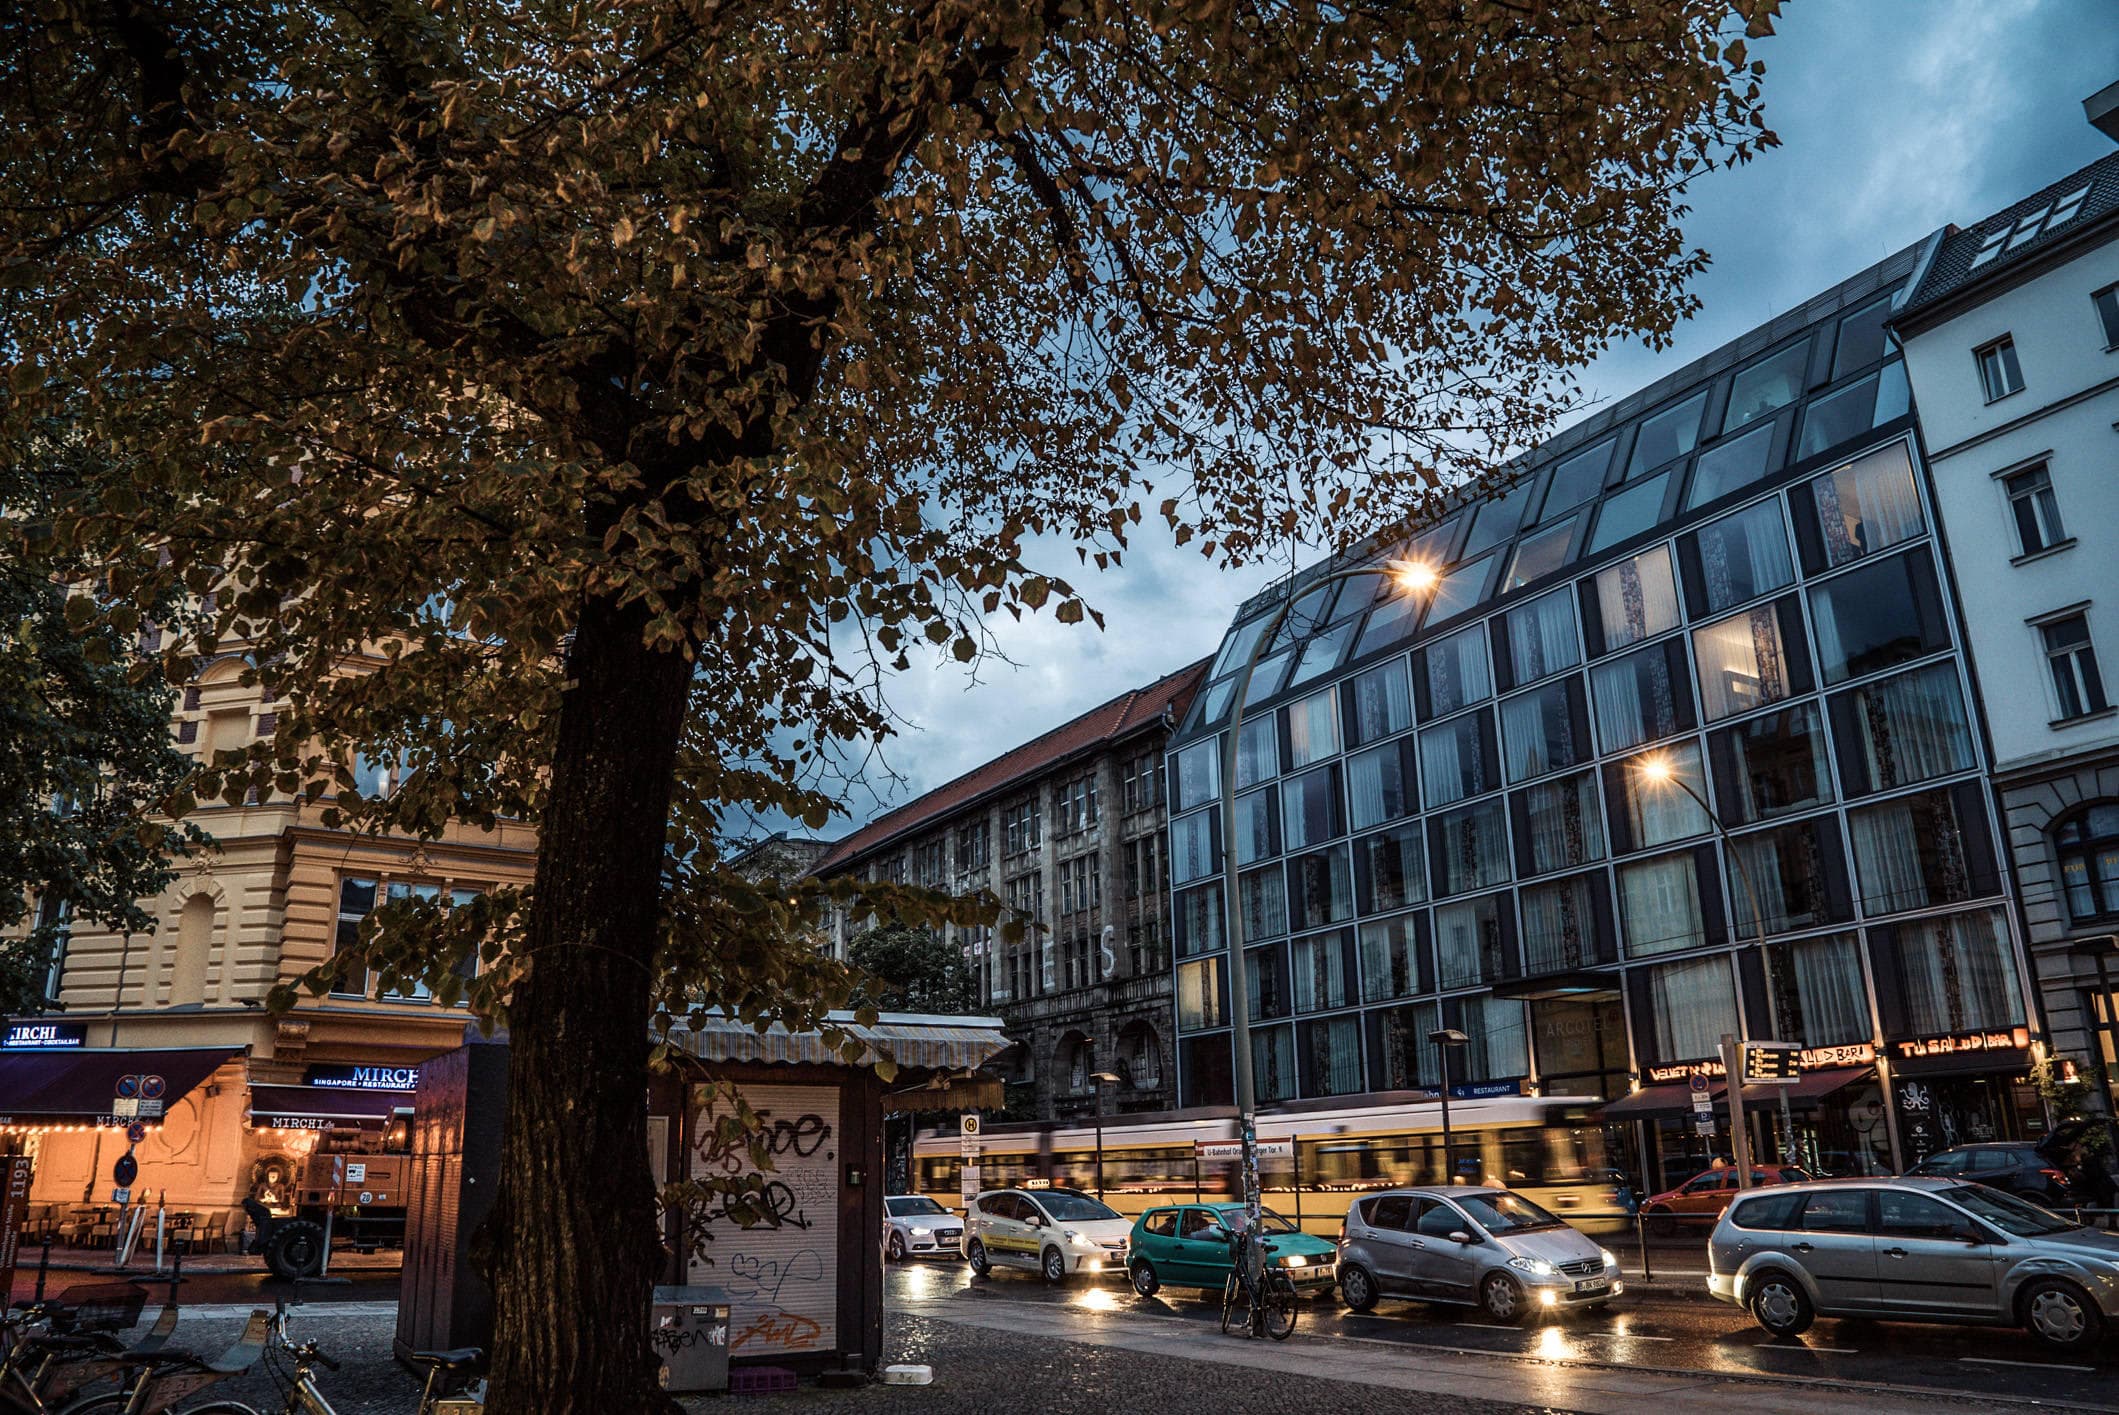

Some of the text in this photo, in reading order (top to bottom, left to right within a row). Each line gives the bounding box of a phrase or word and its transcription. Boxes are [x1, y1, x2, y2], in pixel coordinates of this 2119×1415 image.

[314, 1079, 410, 1089] SINGAPORE RESTAURANT
[1474, 1085, 1510, 1095] RESTAURANT
[10, 1160, 30, 1198] 1193
